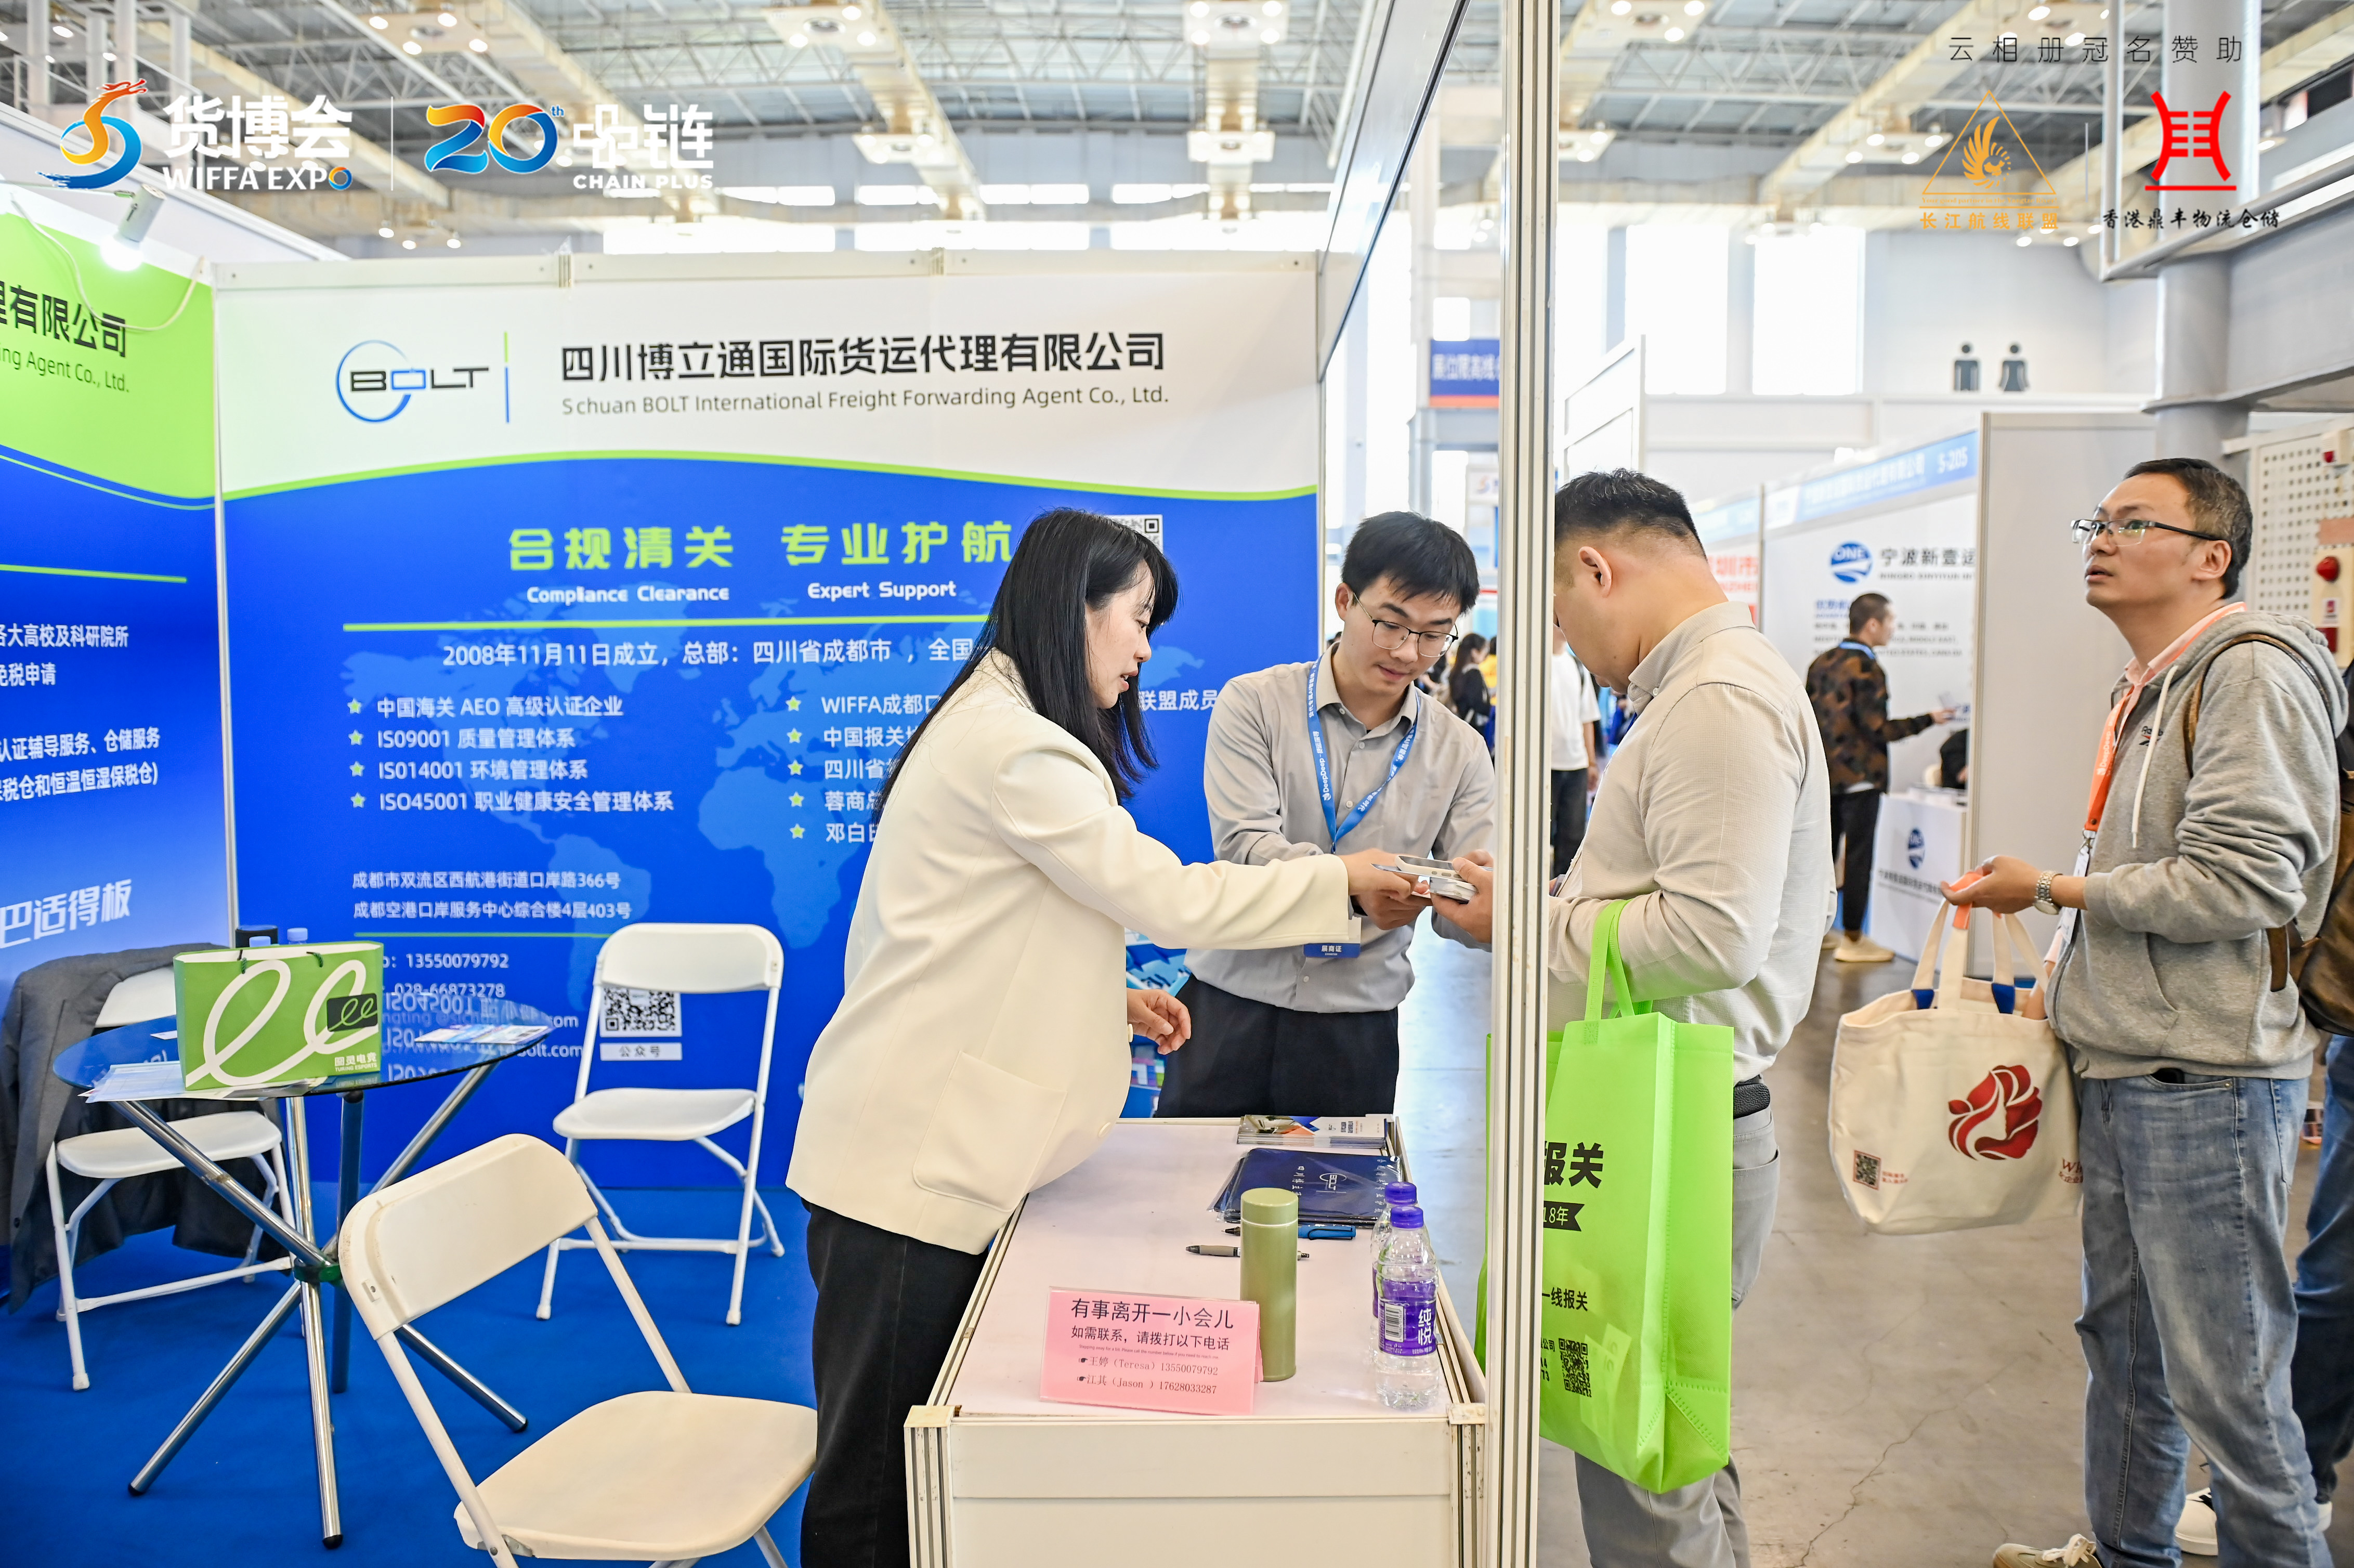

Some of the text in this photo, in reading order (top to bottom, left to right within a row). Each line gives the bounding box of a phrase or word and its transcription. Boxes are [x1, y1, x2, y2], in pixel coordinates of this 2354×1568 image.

[0, 280, 126, 358] 有限公司
[561, 331, 1165, 383] 四川博立通国际货运代理有限公司
[27, 350, 71, 379] Agent
[75, 363, 100, 389] Co.,
[104, 370, 130, 393] Ltd.
[350, 367, 489, 392] BOLT
[643, 395, 689, 414] BOLT
[696, 390, 822, 413] International
[829, 390, 897, 411] Freight
[904, 388, 1016, 409] Forwarding
[1023, 387, 1083, 408] Agent
[1089, 386, 1126, 406] Co.,
[1132, 385, 1169, 403] Ltd.
[509, 520, 1013, 571] 合规清关 专业护航
[527, 579, 957, 606] Compliance Clearance Expert Support
[377, 695, 624, 719] 中国海关 AEO 高级认证企业
[1142, 690, 1219, 712] 联盟成员
[457, 727, 576, 750] 质量管理体系
[2099, 730, 2112, 767] DeepDeep
[469, 759, 588, 781] 环境管理体系
[824, 757, 899, 780] 四川省
[1319, 757, 1329, 793] DeepDeep
[0, 762, 159, 802] 税仓和恒温恒湿保税仓)
[474, 790, 675, 813] 职业健康安全管理体系
[352, 870, 621, 890] 成都市双流区西航港街道口岸路366号
[0, 879, 132, 949] 巴适得板
[354, 900, 632, 920] 成都空港口岸服务中心综合楼4层403号
[407, 952, 509, 969] 13550079792
[394, 983, 506, 998] 028-66873278
[334, 1052, 377, 1067] 图灵电竞
[619, 1046, 660, 1057] 公众号
[355, 1062, 377, 1070] ESPORTS
[1544, 1141, 1604, 1189] 报关
[1328, 1173, 1338, 1191] BOLT
[1541, 1286, 1588, 1312] 一线报关
[1070, 1298, 1234, 1329] 有事离开一小会儿
[1071, 1325, 1230, 1351] 如需联系，请拨打以下电话
[1418, 1308, 1432, 1346] 纯悦
[1088, 1356, 1109, 1367] 王婷
[1160, 1362, 1218, 1376] 13550079792
[1159, 1380, 1218, 1394] 17628033287
